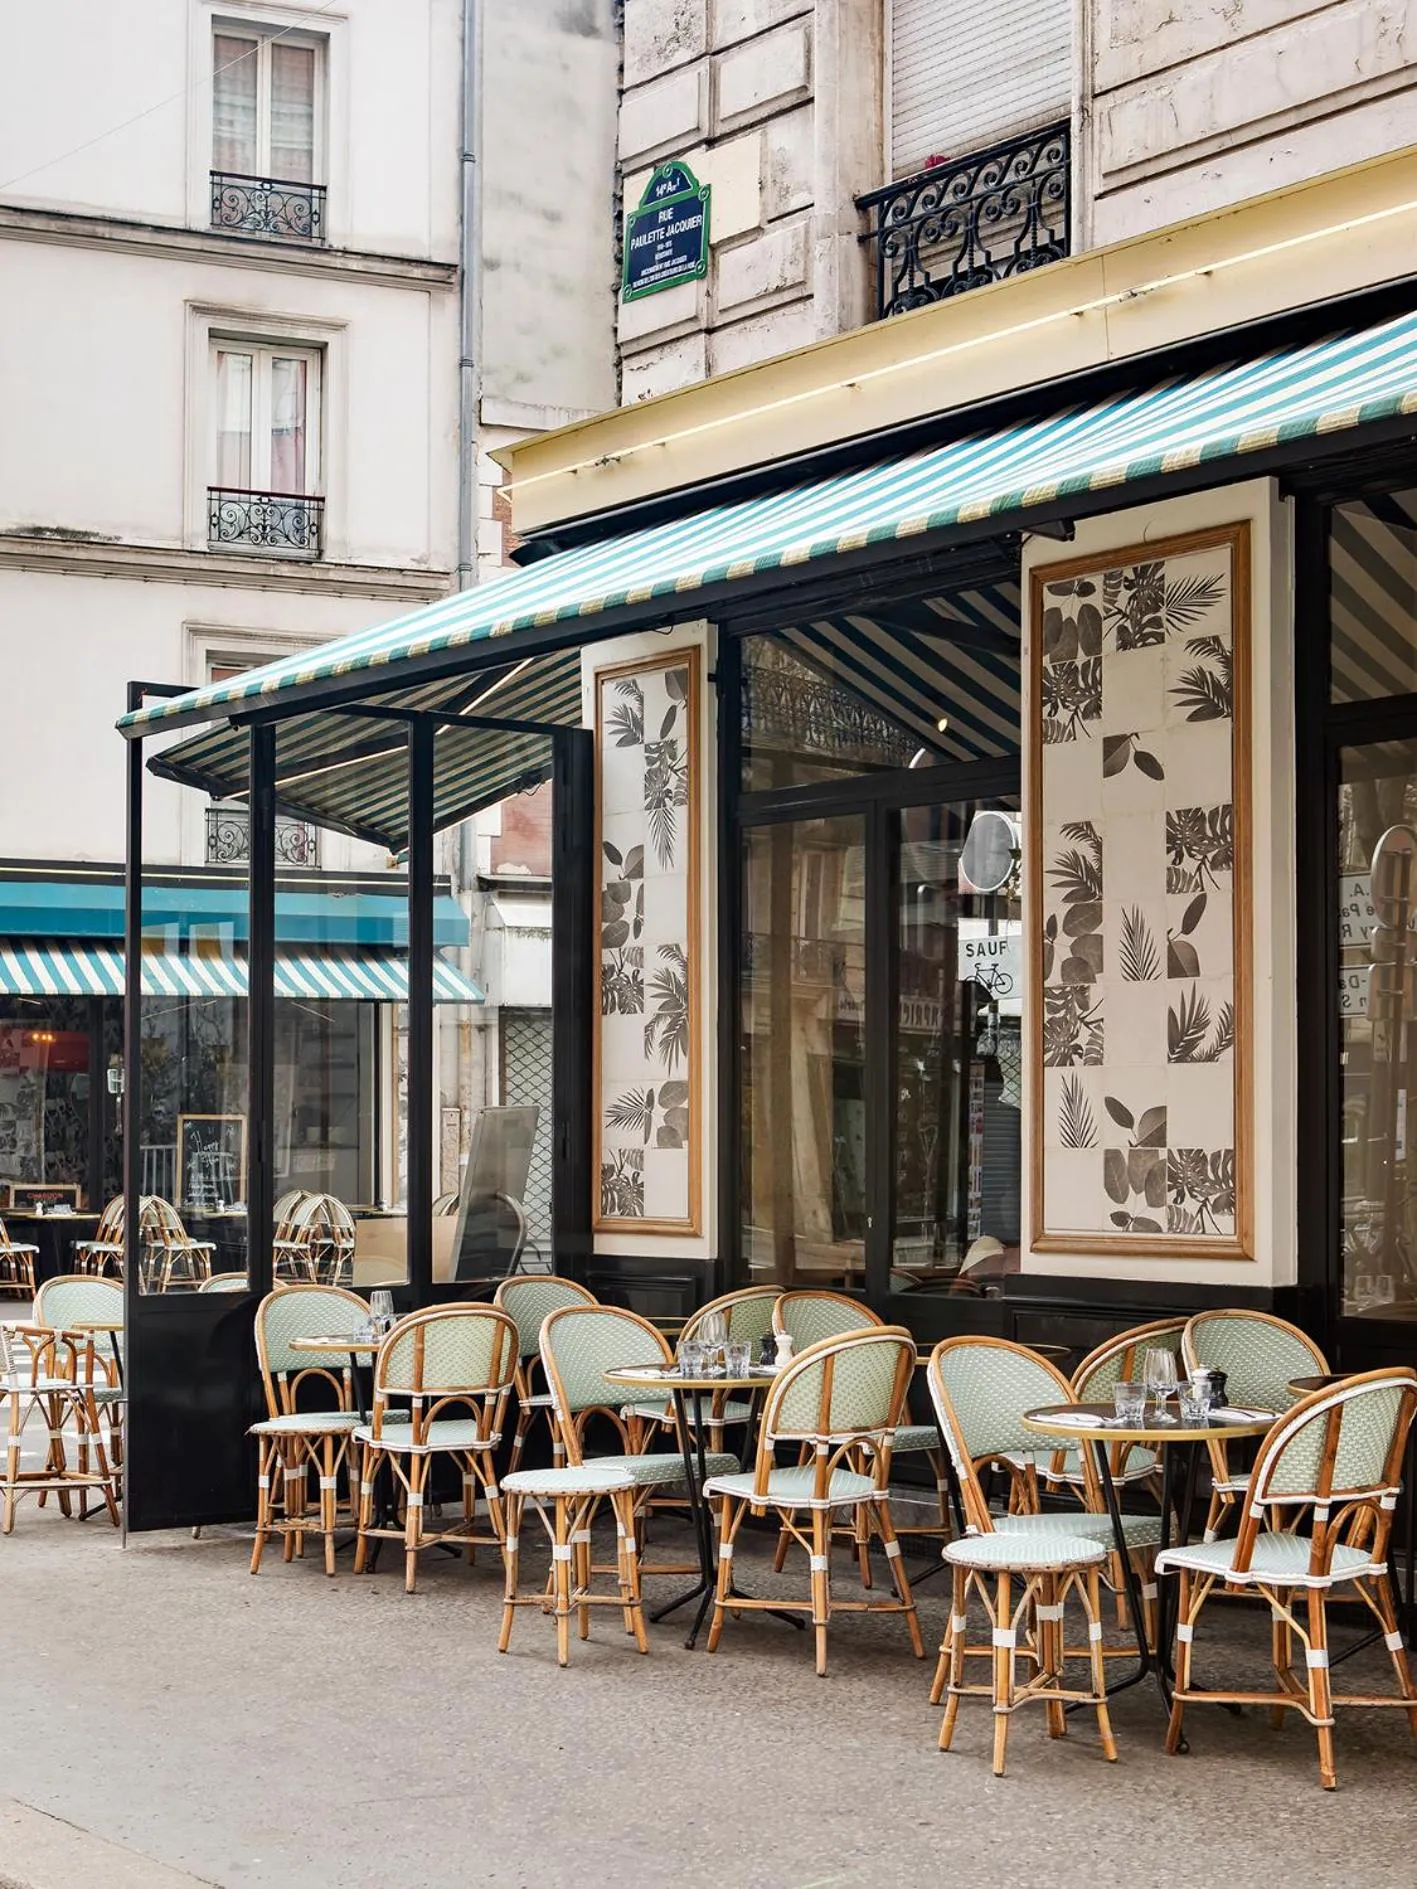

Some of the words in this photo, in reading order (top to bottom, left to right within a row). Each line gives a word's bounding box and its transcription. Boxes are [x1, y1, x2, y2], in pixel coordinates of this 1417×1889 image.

[658, 207, 674, 223] RUE
[630, 227, 665, 251] PAULETTE
[666, 215, 702, 237] JACQUIER
[965, 940, 1008, 958] SAUF
